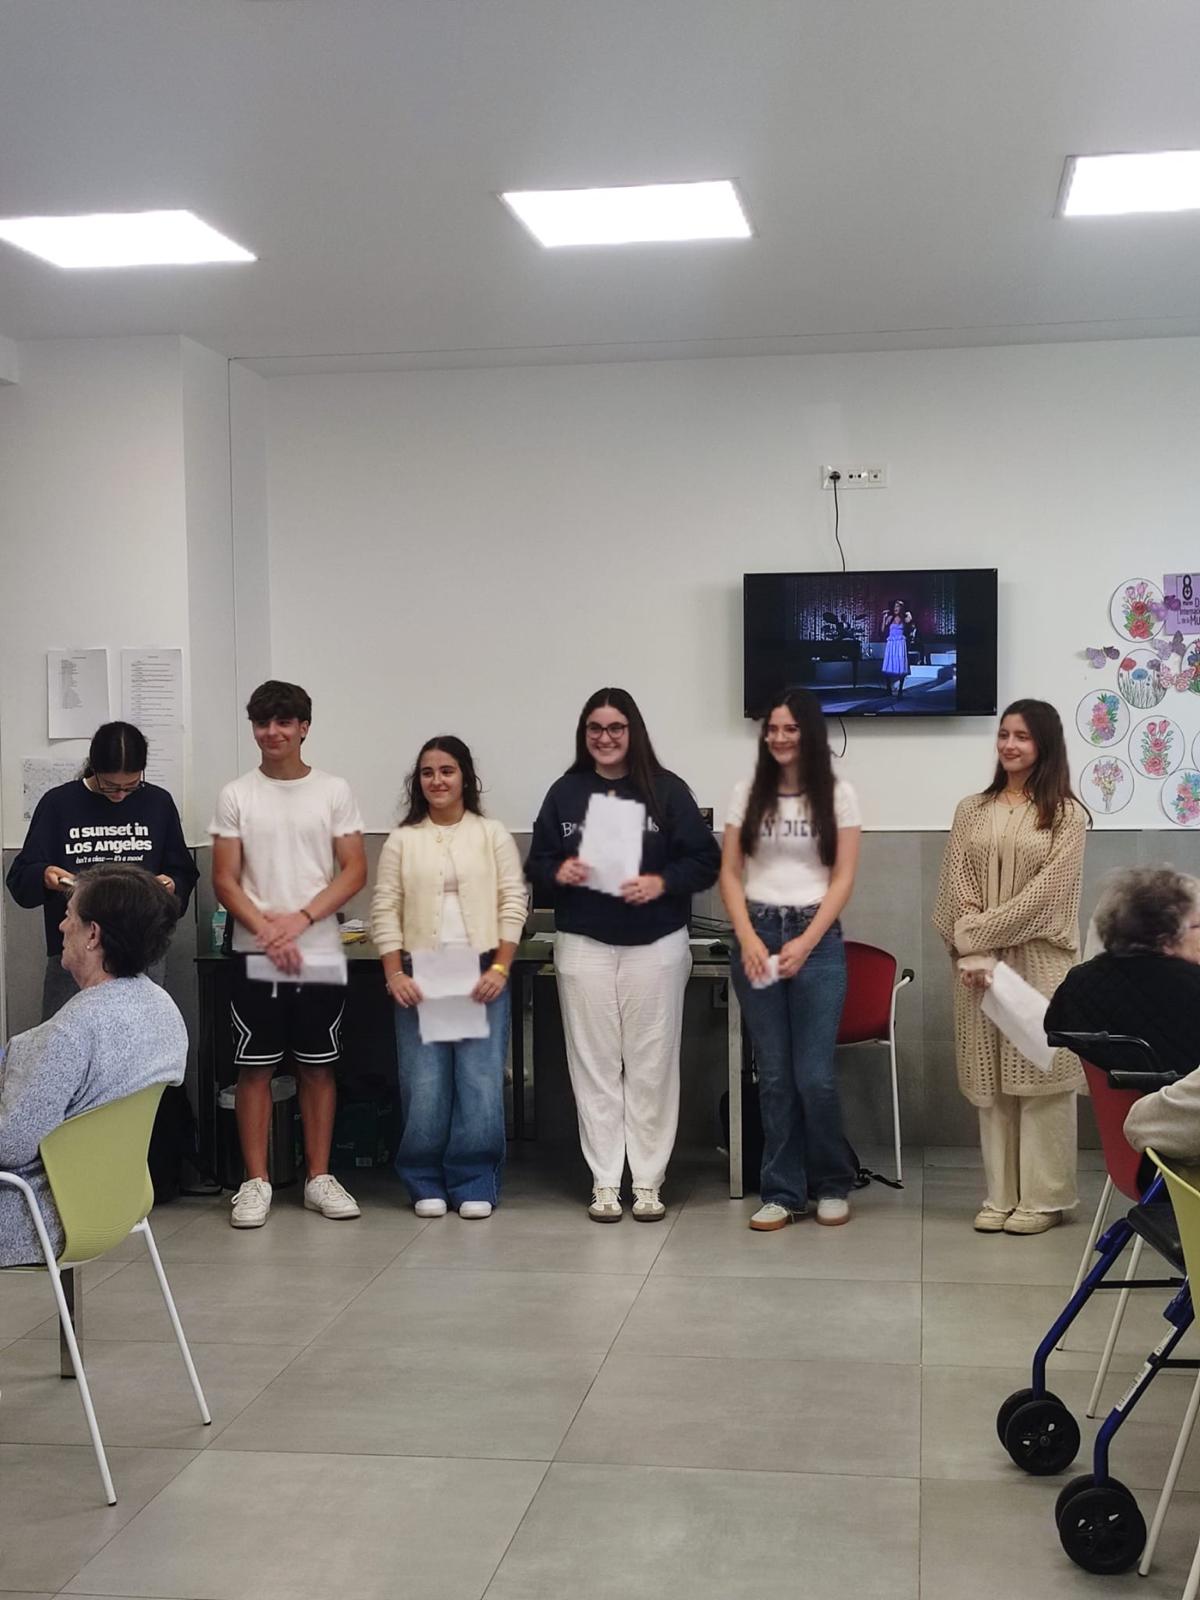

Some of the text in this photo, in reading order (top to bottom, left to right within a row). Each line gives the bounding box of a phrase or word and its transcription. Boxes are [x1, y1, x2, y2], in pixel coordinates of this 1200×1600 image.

[1183, 575, 1193, 601] 8
[69, 822, 149, 839] a sunset in
[94, 837, 152, 854] Angeles
